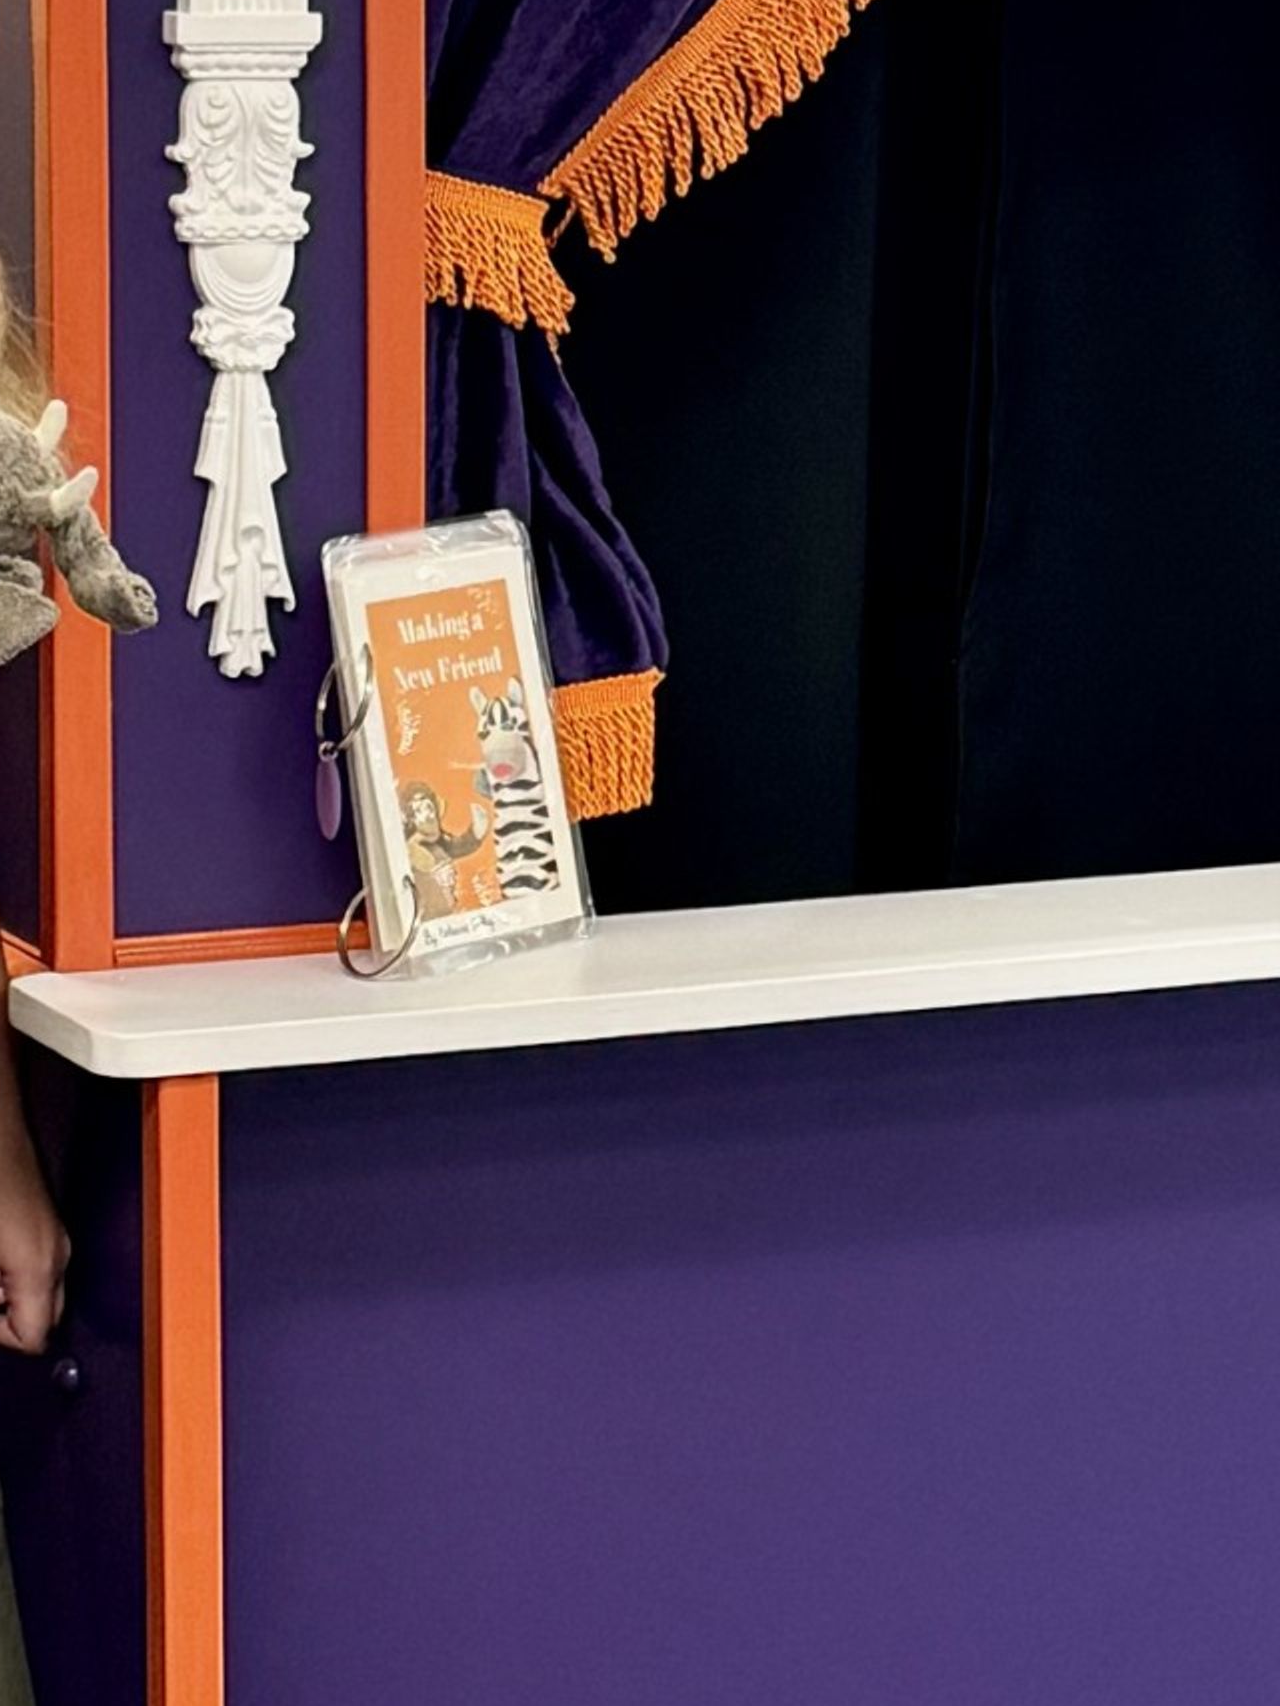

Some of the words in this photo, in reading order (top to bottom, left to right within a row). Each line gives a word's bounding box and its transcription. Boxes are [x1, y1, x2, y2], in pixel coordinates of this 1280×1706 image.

[397, 610, 472, 644] Making
[472, 612, 484, 631] a
[393, 665, 436, 693] New
[437, 645, 503, 684] Friend
